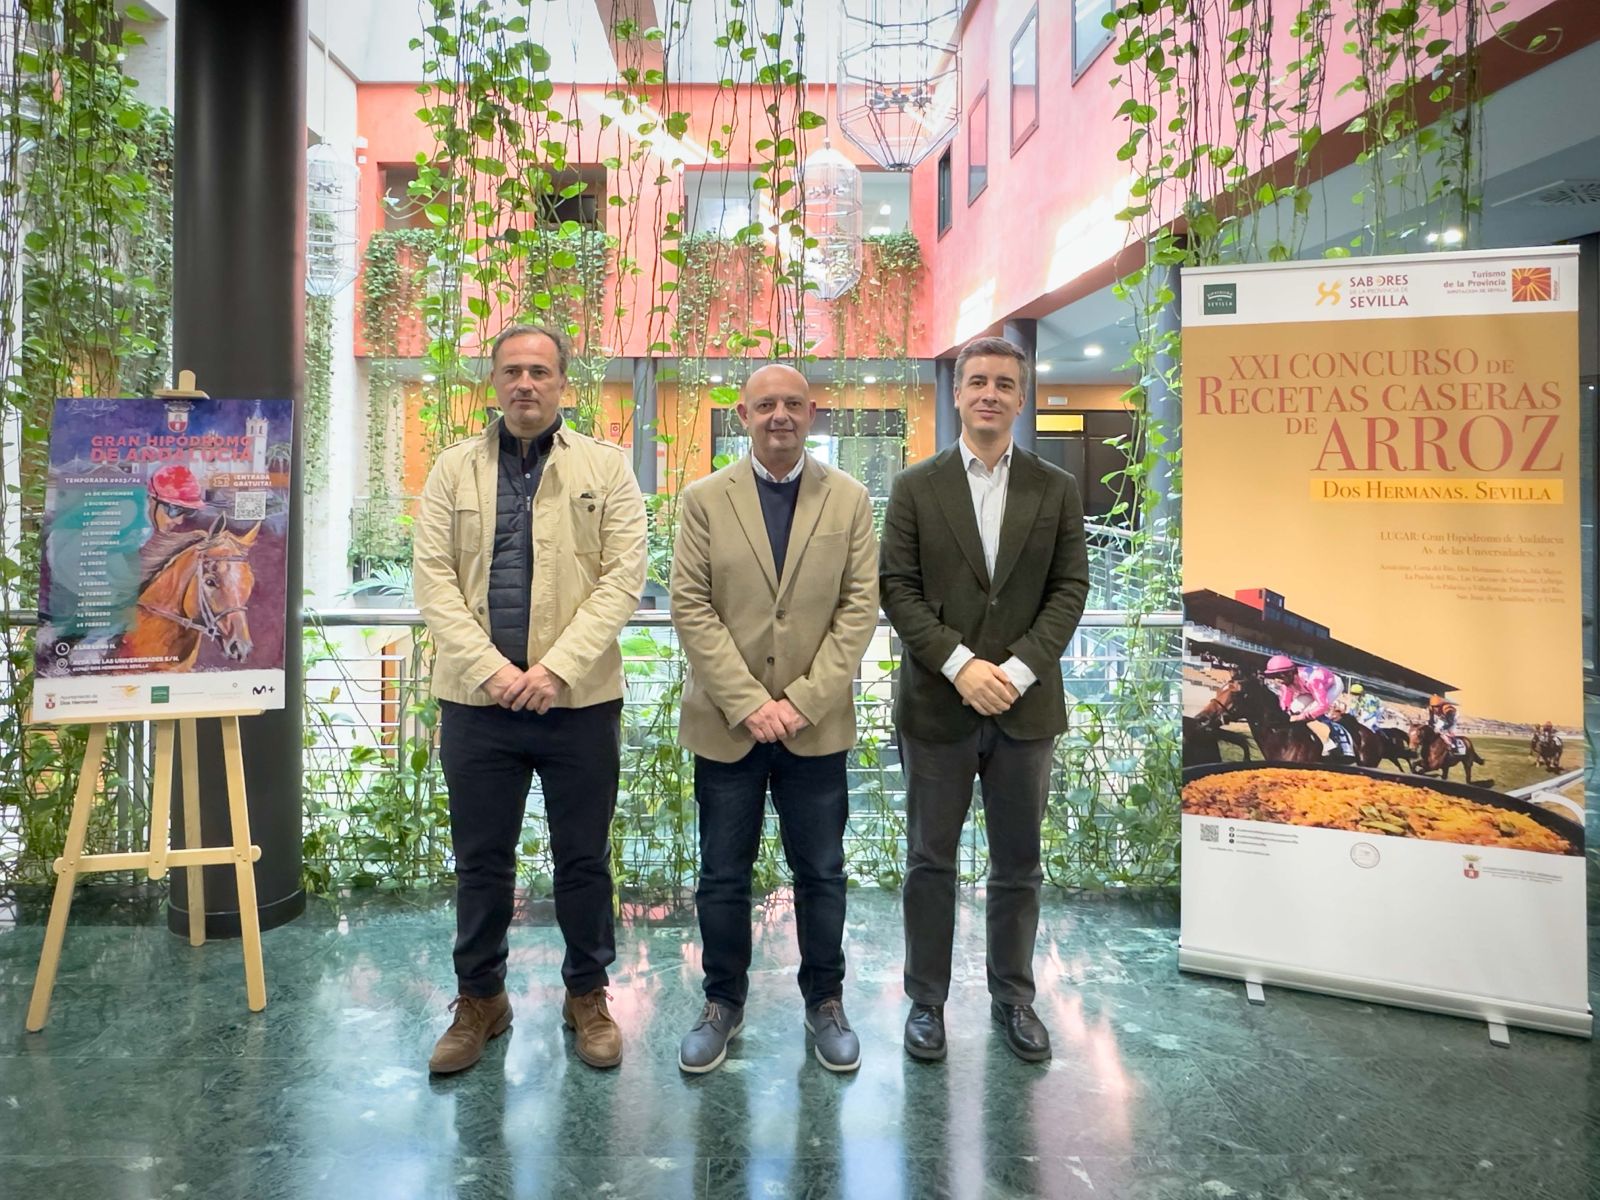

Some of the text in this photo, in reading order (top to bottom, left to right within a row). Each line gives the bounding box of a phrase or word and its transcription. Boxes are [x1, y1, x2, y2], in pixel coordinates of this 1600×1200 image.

[1349, 274, 1409, 288] SABORES
[1472, 270, 1506, 279] Turismo
[1457, 280, 1465, 288] la
[1467, 278, 1506, 287] Provincia
[1349, 295, 1409, 309] SEVILLA
[1229, 347, 1514, 381] XXI CONCURSO DE
[1382, 381, 1561, 413] CASERAS
[91, 435, 140, 447] GRAN
[1286, 414, 1564, 472] DE ARROZ
[90, 448, 120, 462] DE
